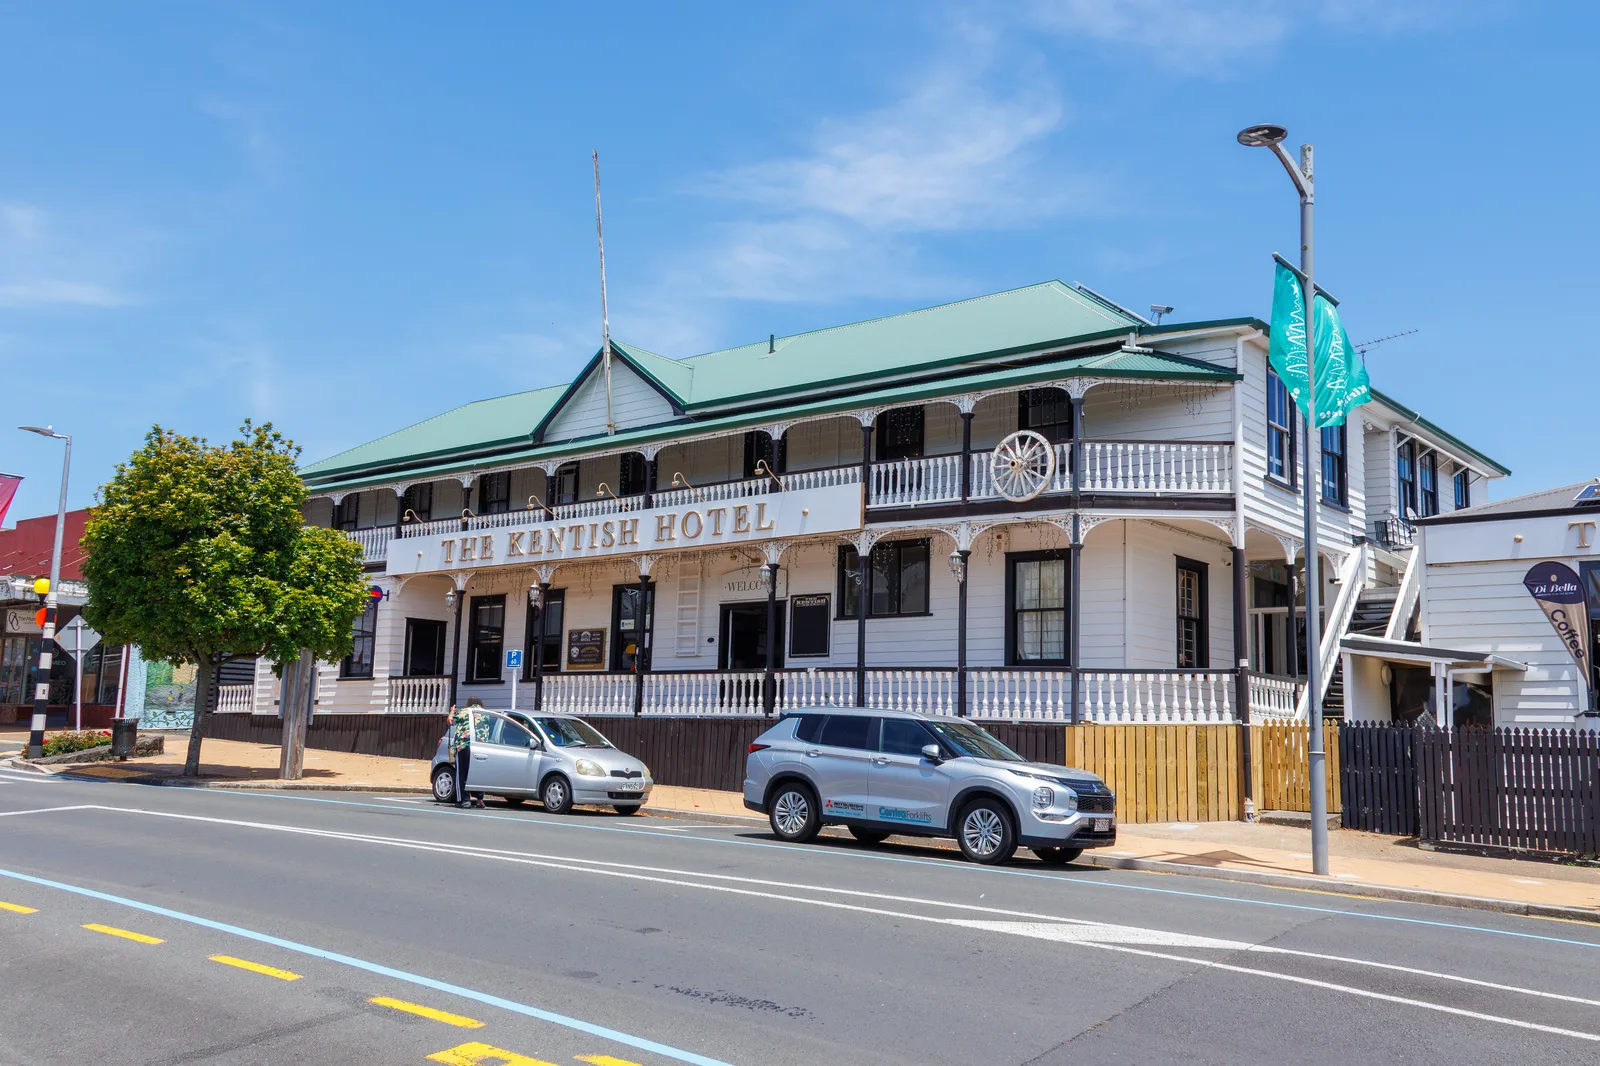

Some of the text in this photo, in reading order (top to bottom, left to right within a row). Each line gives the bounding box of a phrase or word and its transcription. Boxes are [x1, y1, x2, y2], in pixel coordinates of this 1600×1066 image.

[441, 502, 775, 563] THE KENTISH HOTEL
[728, 580, 773, 592] WELCO
[1534, 582, 1577, 593] Di Bella
[1551, 608, 1585, 660] Coffee
